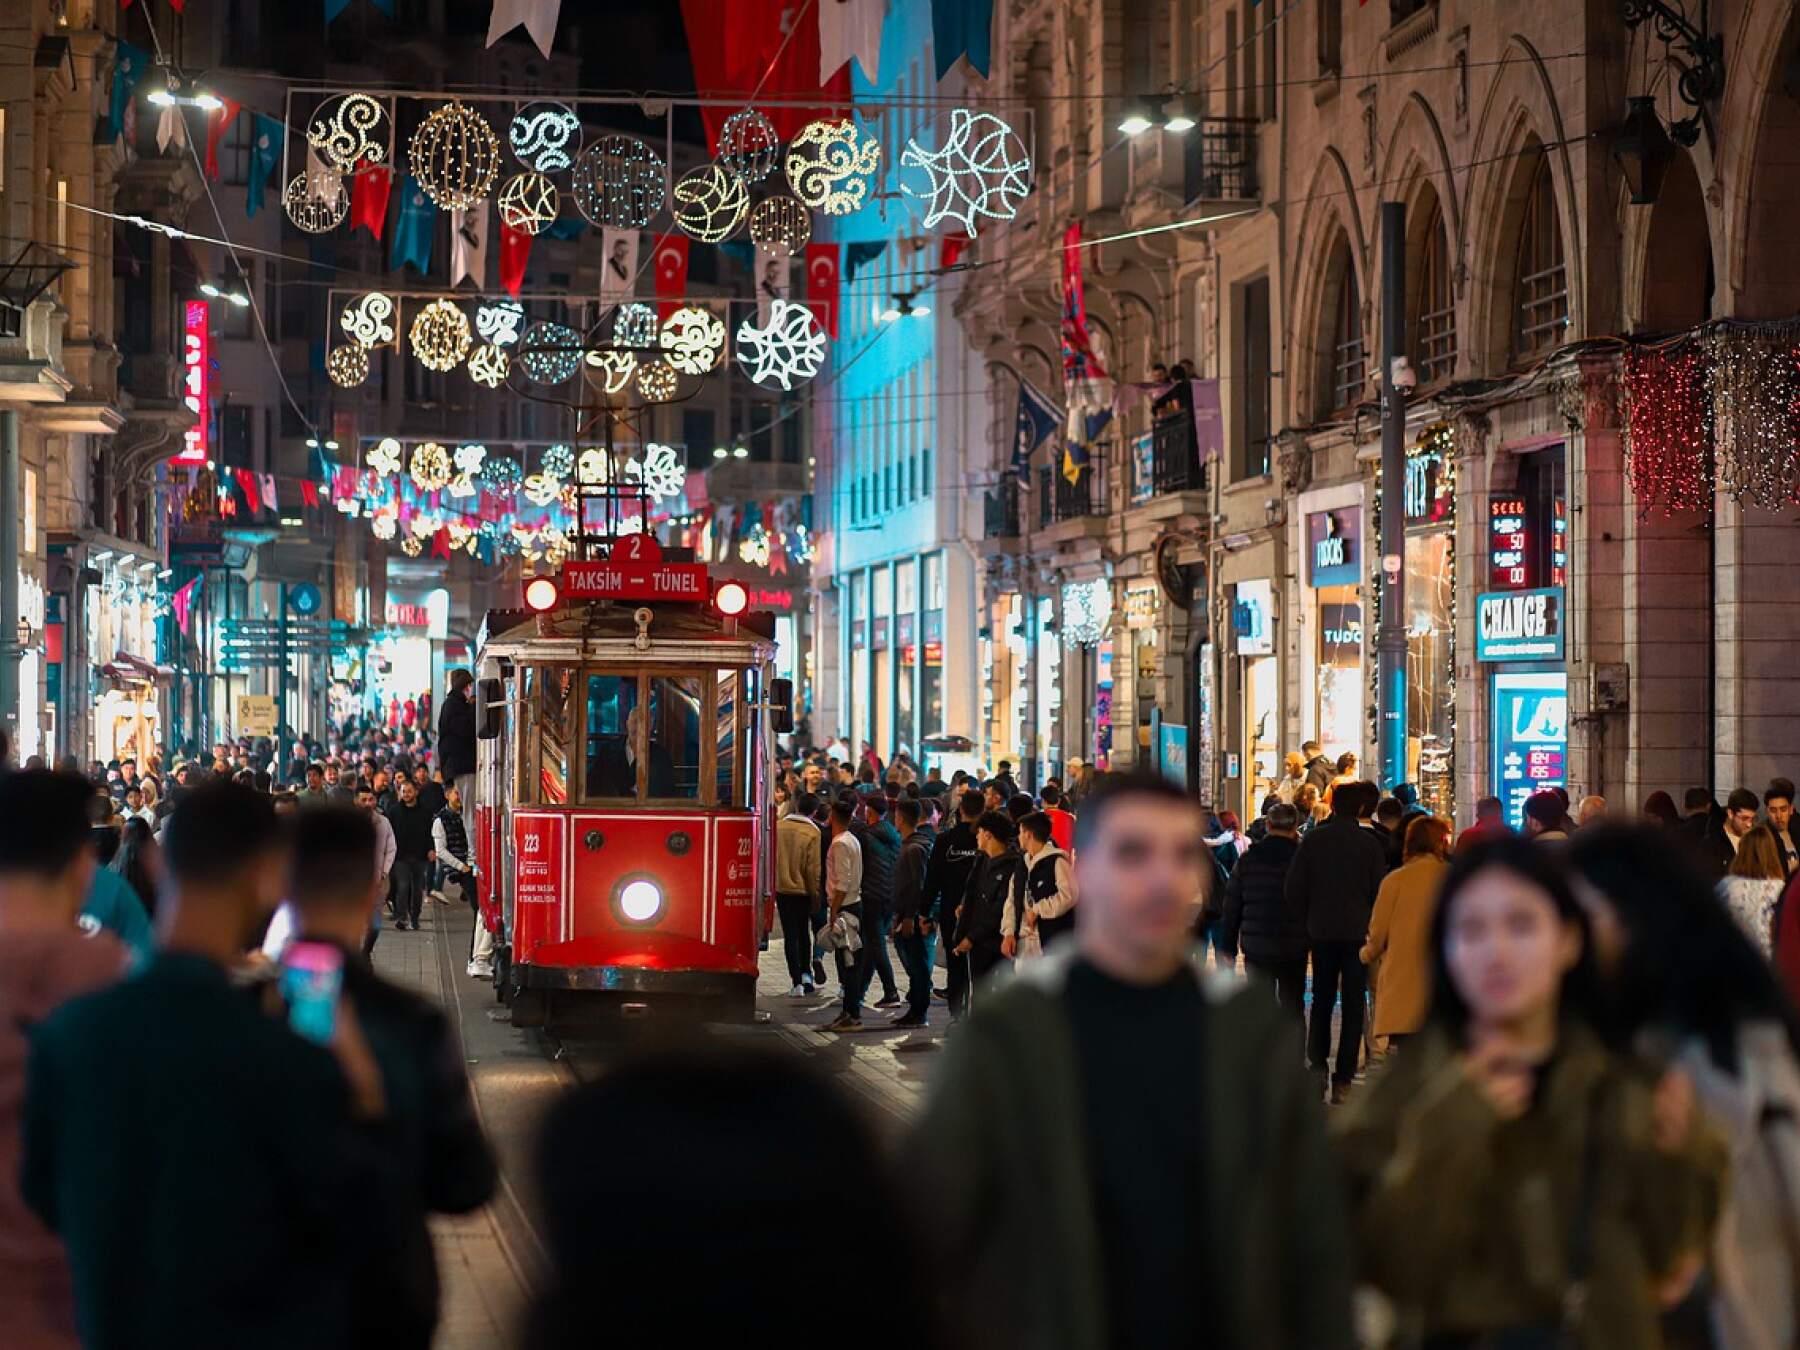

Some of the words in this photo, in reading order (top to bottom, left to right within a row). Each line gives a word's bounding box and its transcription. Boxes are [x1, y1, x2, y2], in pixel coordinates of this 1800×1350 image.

[630, 537, 641, 560] 2
[569, 567, 622, 590] TAKSİM
[652, 571, 699, 593] TÜNEL
[1480, 595, 1547, 640] CHANGE
[525, 834, 540, 853] 223
